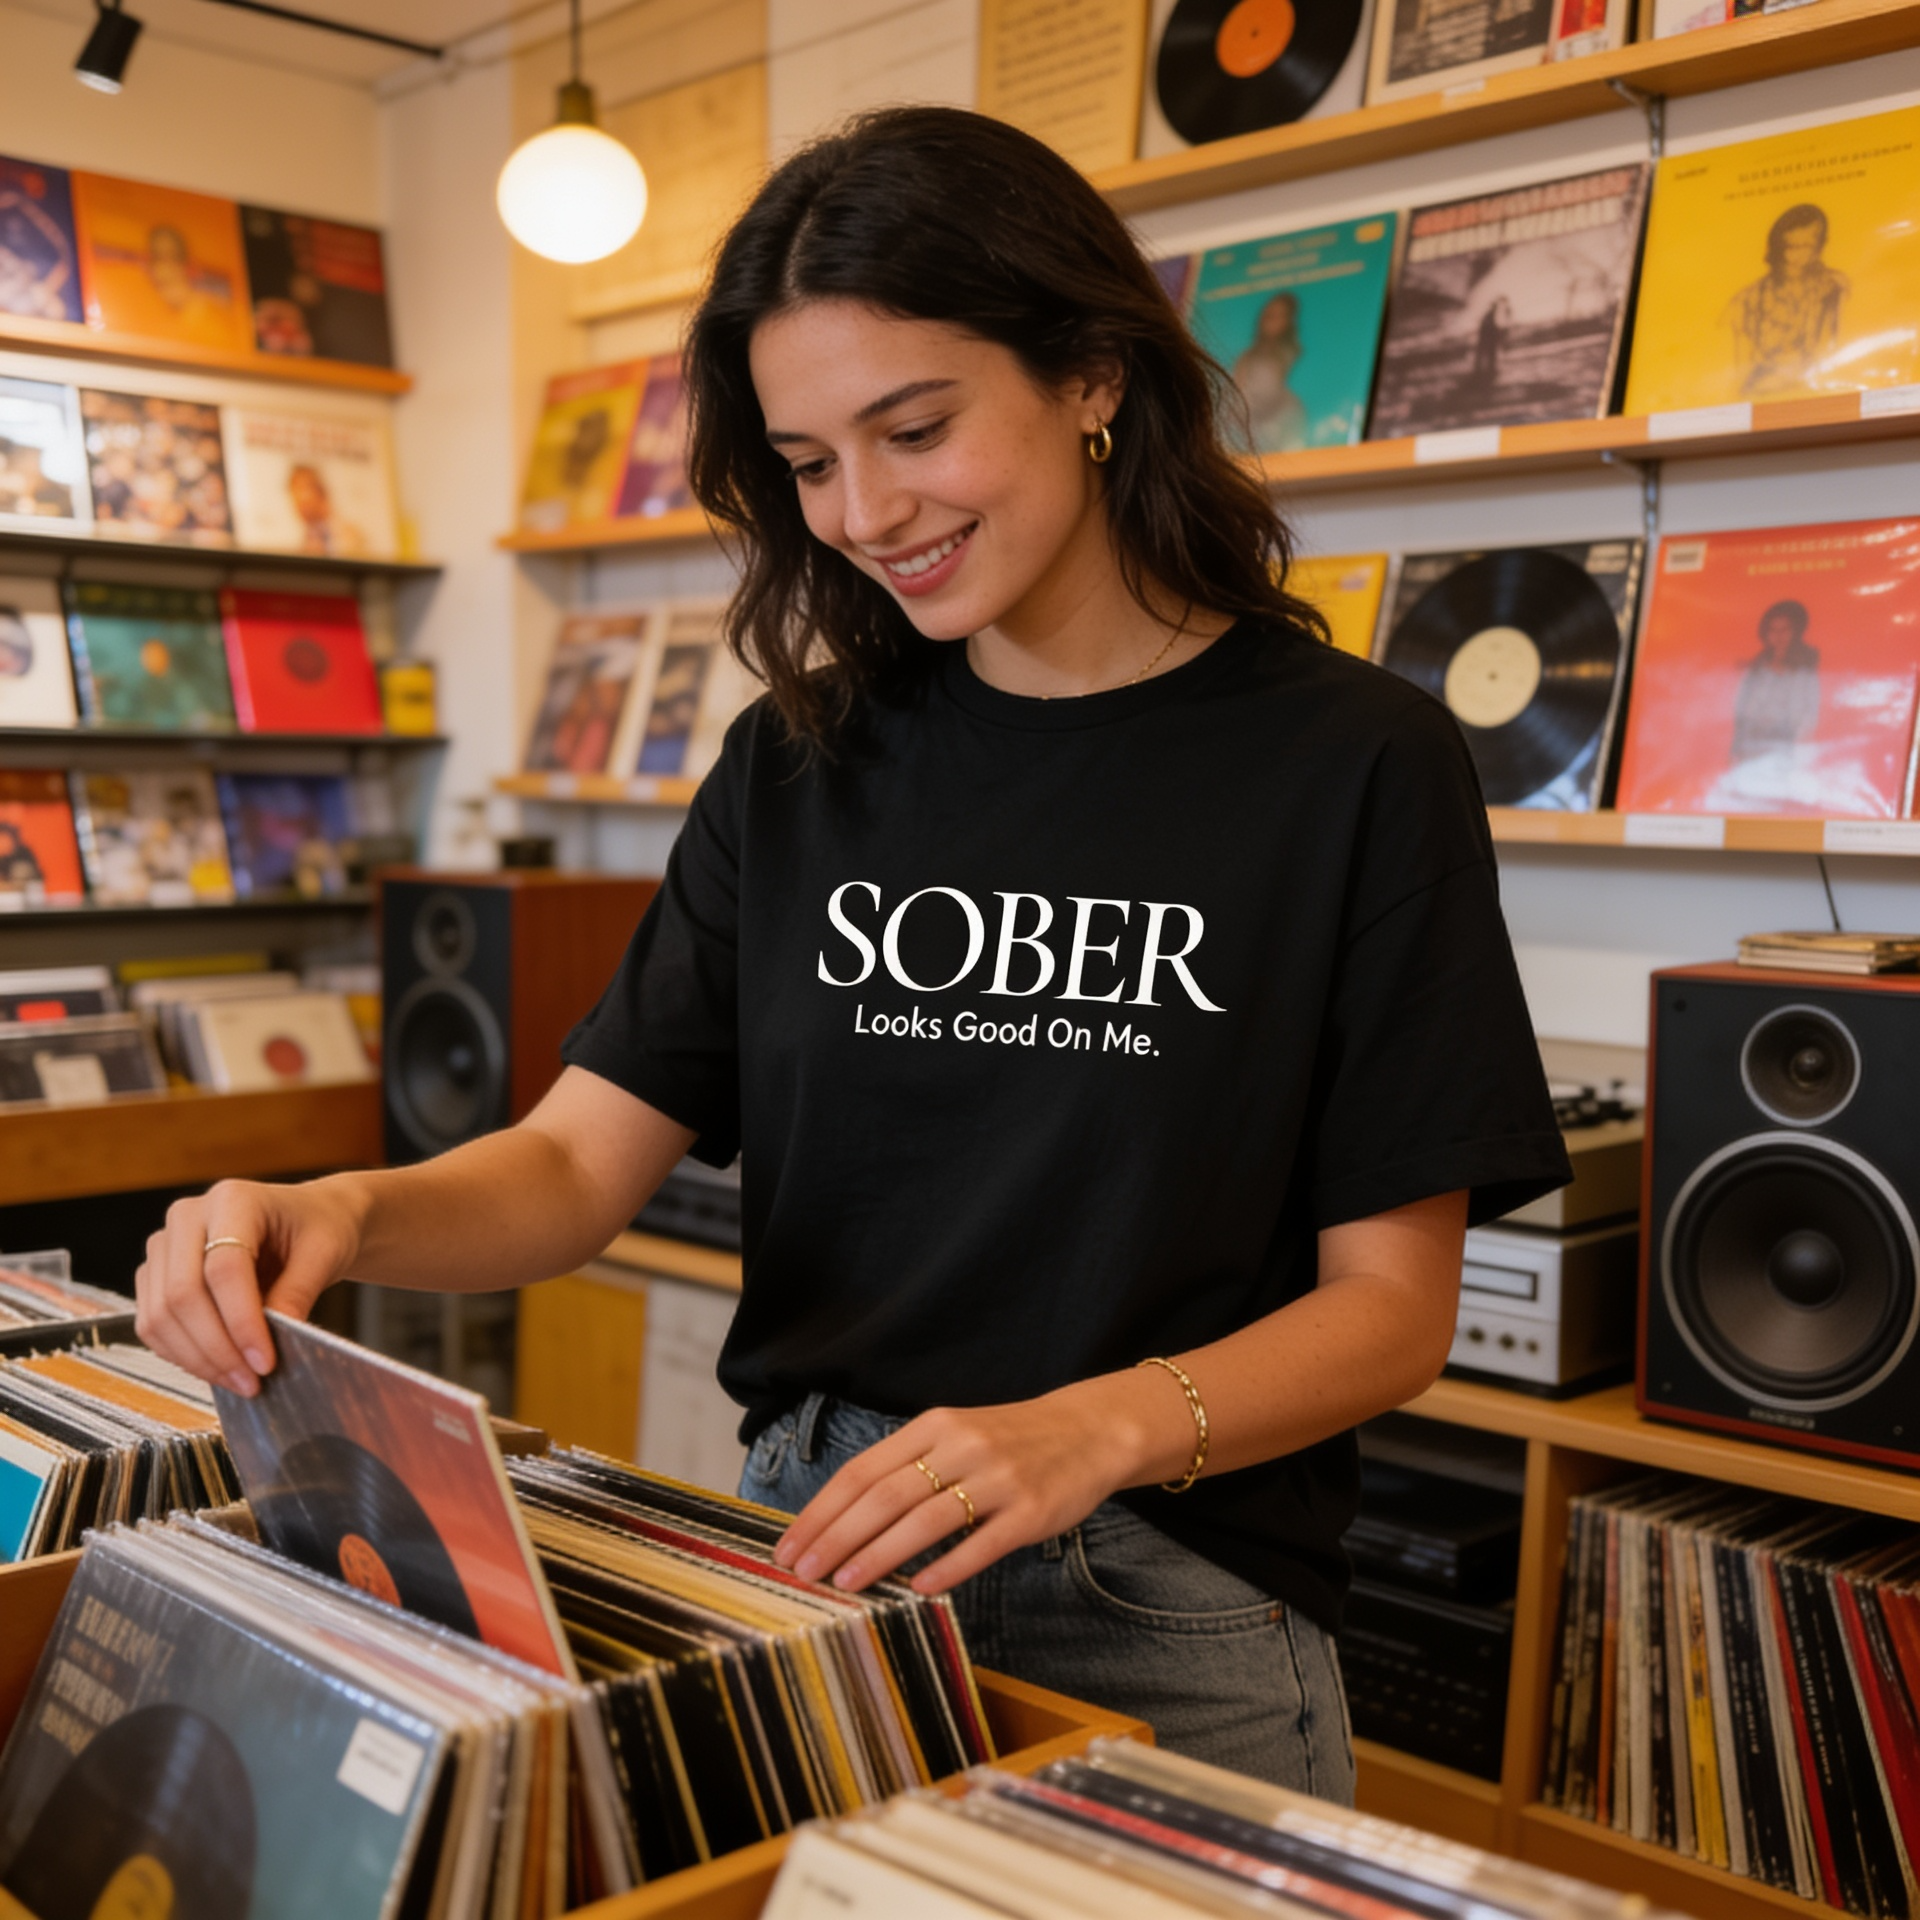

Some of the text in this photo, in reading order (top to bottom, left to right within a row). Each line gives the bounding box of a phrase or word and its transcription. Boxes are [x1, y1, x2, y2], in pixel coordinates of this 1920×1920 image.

[817, 881, 1228, 1012] SOBER
[854, 1003, 1160, 1057] Looks Good On Me.
